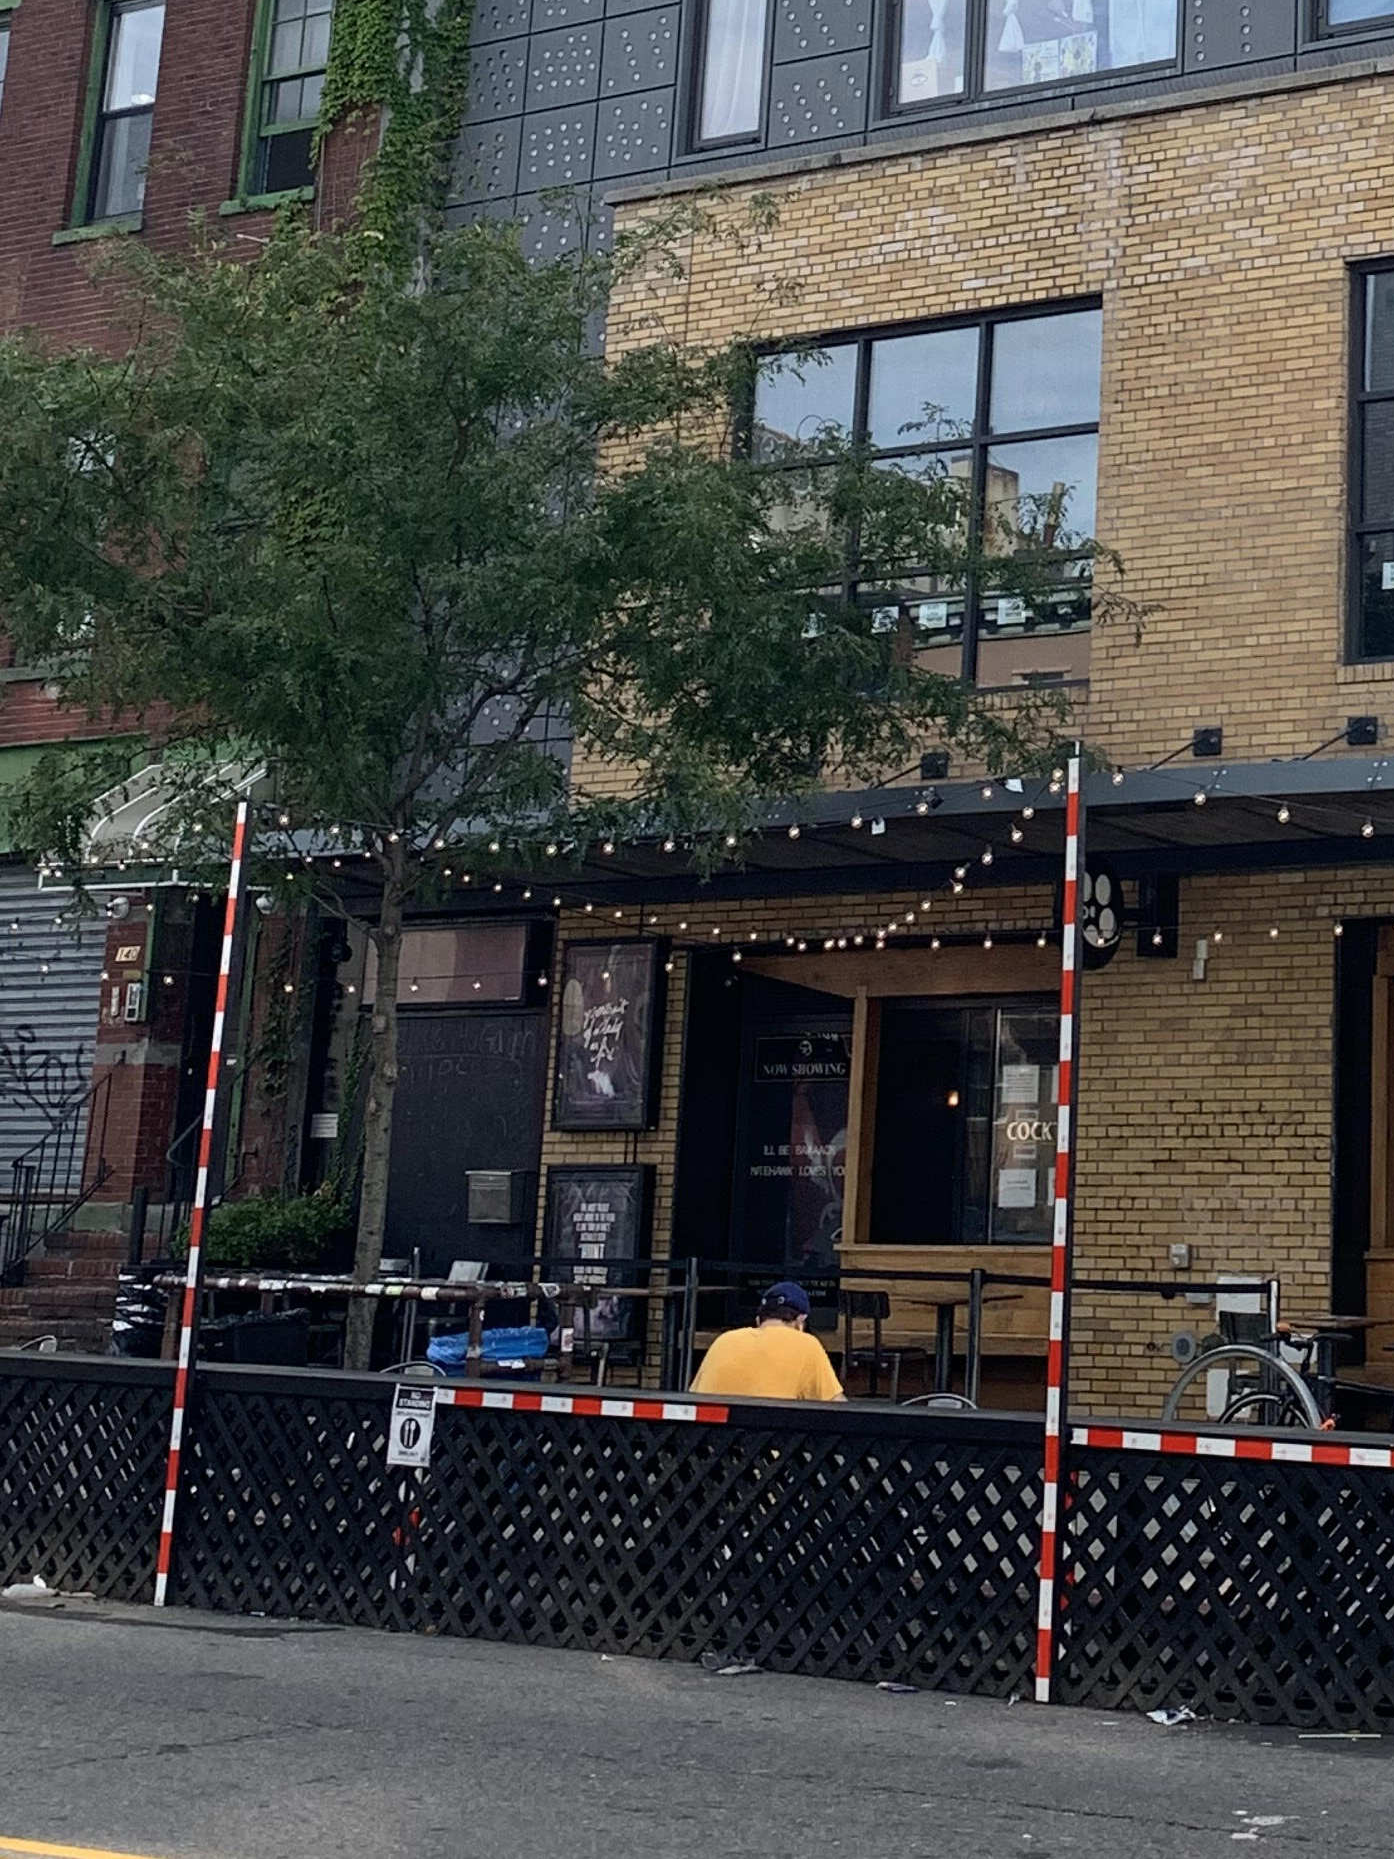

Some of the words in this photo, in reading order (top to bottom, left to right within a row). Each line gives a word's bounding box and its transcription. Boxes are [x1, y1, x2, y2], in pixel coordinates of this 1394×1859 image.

[763, 1063, 788, 1076] NOW
[792, 1061, 847, 1076] SHOWING
[1006, 1121, 1057, 1141] COCK
[410, 1391, 422, 1400] NO
[398, 1398, 432, 1410] STANDING
